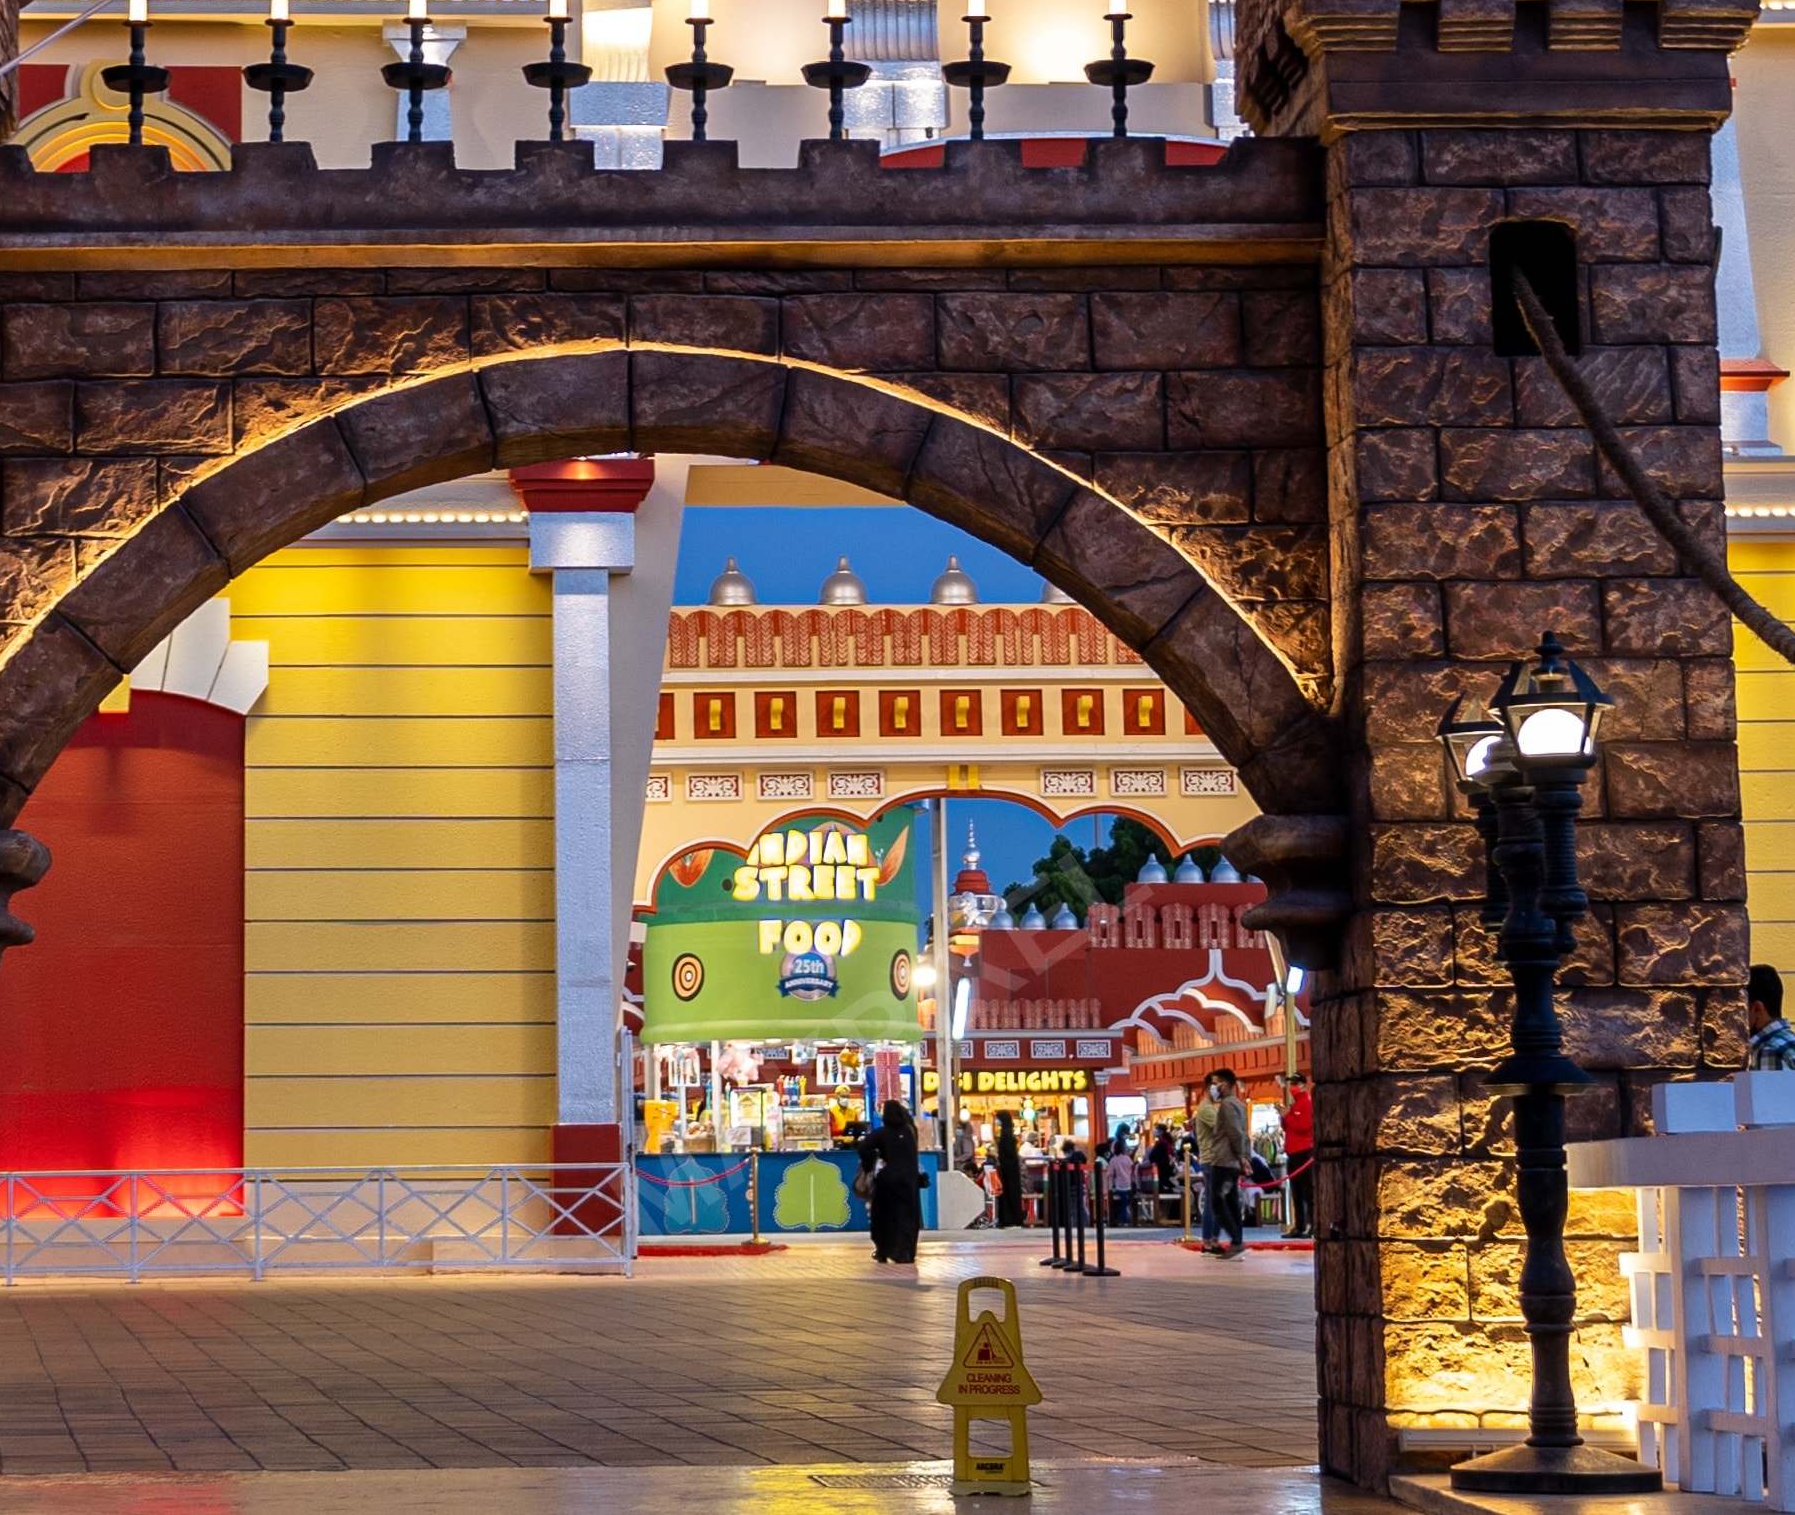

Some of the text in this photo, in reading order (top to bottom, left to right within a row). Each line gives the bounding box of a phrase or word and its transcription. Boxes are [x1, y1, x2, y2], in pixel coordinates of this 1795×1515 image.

[732, 864, 880, 901] STREET
[758, 919, 862, 956] FOOD
[794, 959, 825, 974] 25th
[923, 1071, 973, 1092] DSI
[978, 1070, 1087, 1092] DELIGHTS
[966, 1373, 1012, 1383] CLEANING
[958, 1384, 1021, 1395] IN PROGRESS
